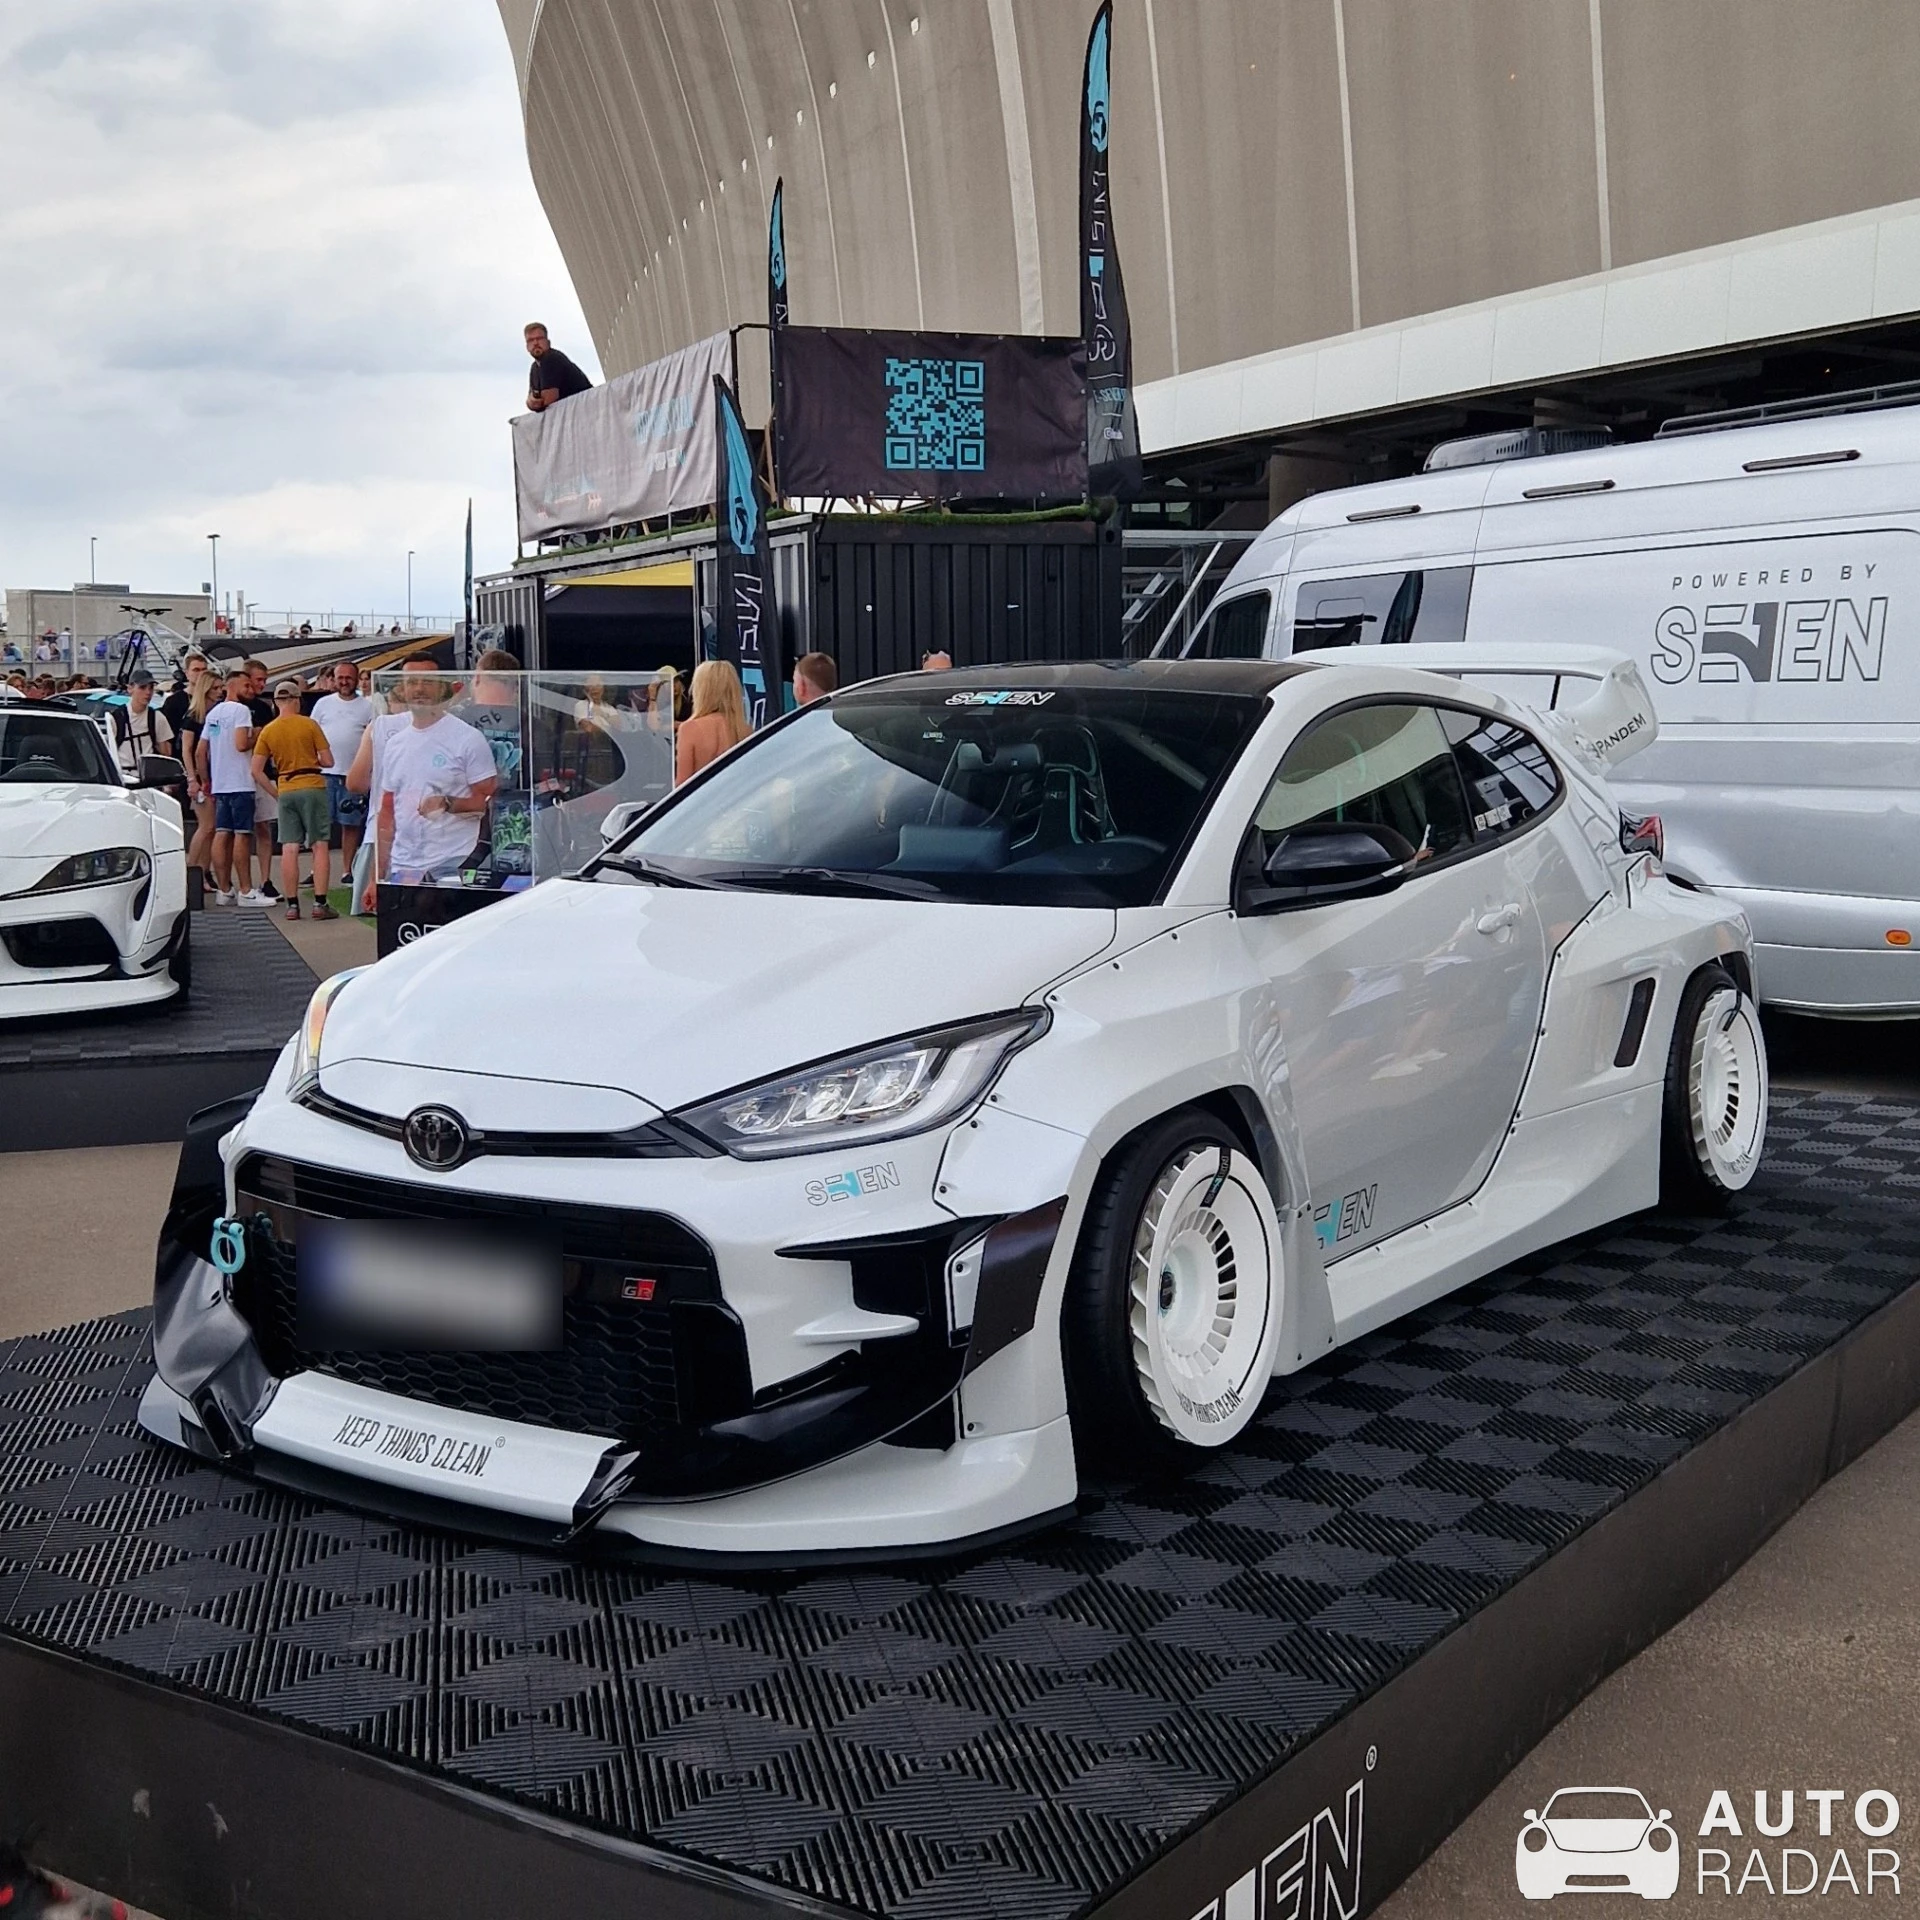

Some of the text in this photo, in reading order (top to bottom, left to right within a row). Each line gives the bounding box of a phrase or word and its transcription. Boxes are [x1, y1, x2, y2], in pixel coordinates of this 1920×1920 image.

[1672, 563, 1877, 590] POWERED BY
[1650, 596, 1889, 685] SEVEN
[945, 691, 1056, 706] SEVEN
[1595, 712, 1647, 755] PANDEM
[805, 1161, 900, 1206] SEVEN
[624, 1286, 652, 1298] GR
[333, 1414, 492, 1477] KEEP THINGS CLEAN.
